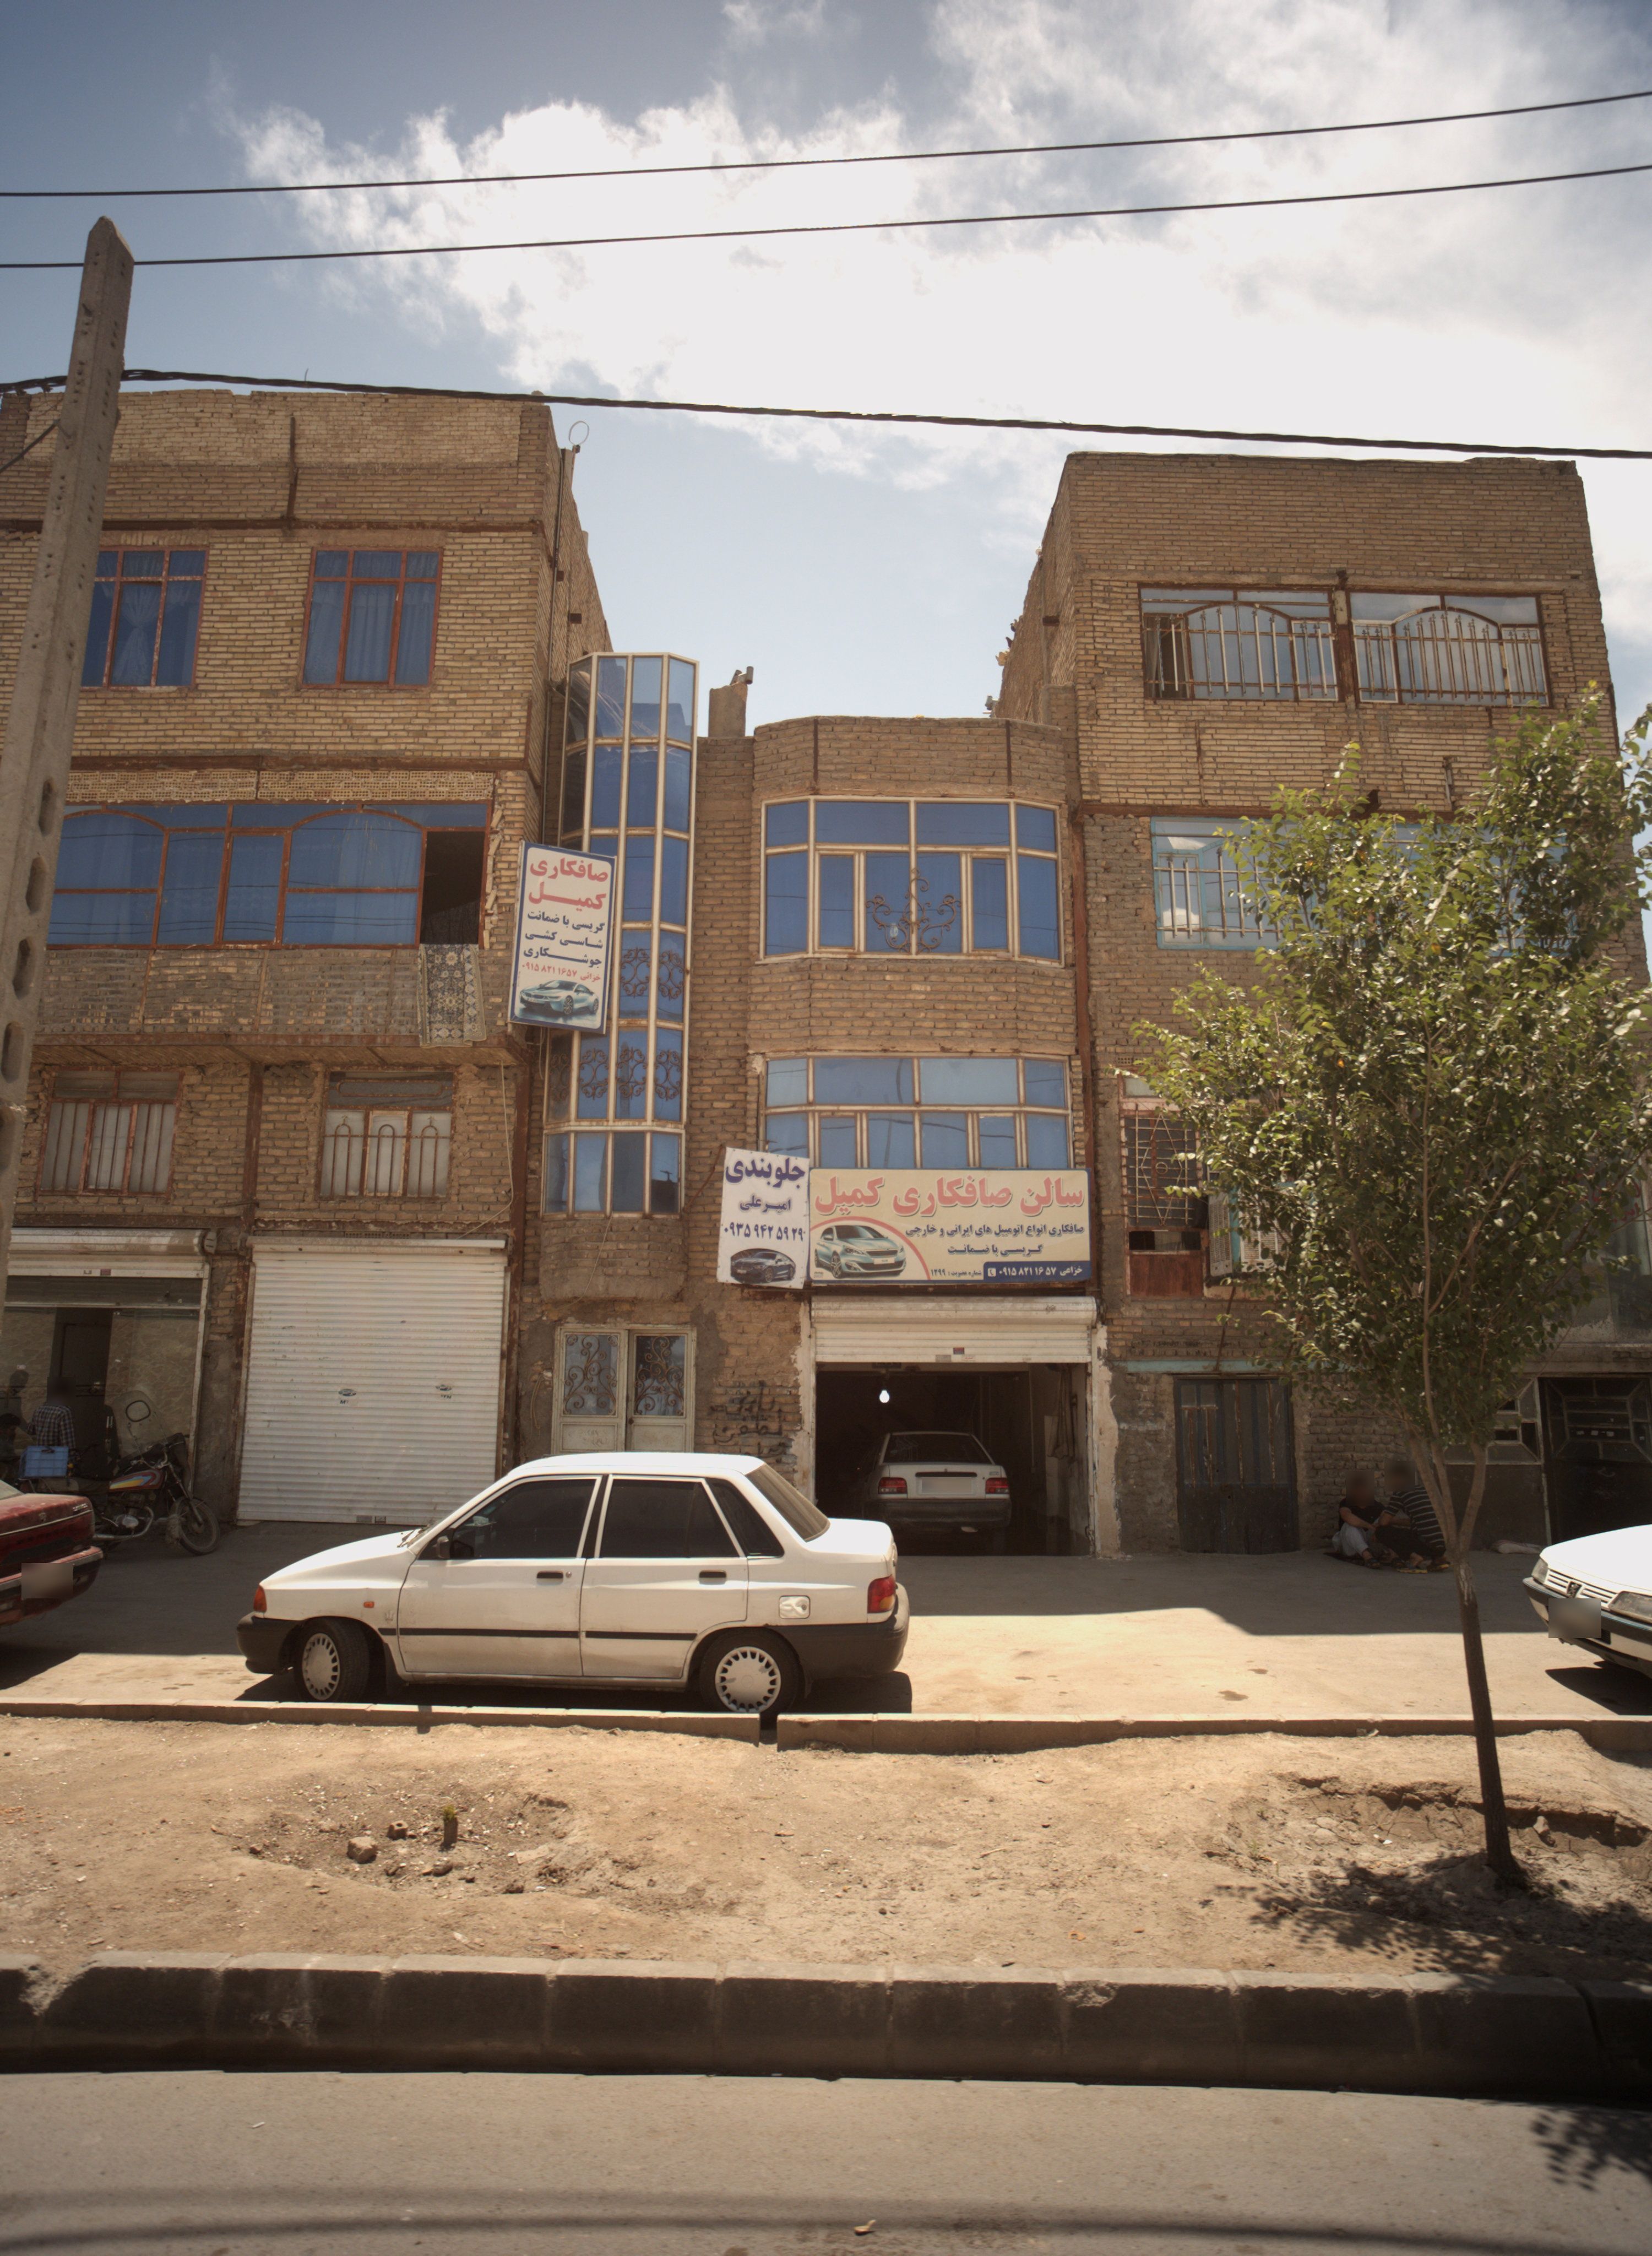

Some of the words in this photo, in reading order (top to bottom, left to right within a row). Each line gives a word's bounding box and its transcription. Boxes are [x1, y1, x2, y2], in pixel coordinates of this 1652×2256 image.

[530, 857, 608, 882] صافکاری
[528, 881, 607, 912] کمیل
[527, 910, 560, 923] ضمانت
[562, 915, 569, 928] با
[525, 930, 558, 941] کشی
[559, 937, 604, 949] شاسی
[524, 946, 602, 969] جوشکاری
[725, 1157, 806, 1189] جلوبندی
[815, 1176, 884, 1215] کمیل
[892, 1175, 1013, 1217] صافکاری
[1019, 1177, 1085, 1216] سالن
[905, 1224, 937, 1237] خارجی
[939, 1228, 944, 1237] و
[947, 1224, 972, 1237] ایرانی
[975, 1224, 991, 1236] های
[1025, 1224, 1046, 1237] انواع
[1048, 1224, 1085, 1237] صافکاری
[948, 1243, 990, 1254] ضمانت
[992, 1244, 998, 1256] با
